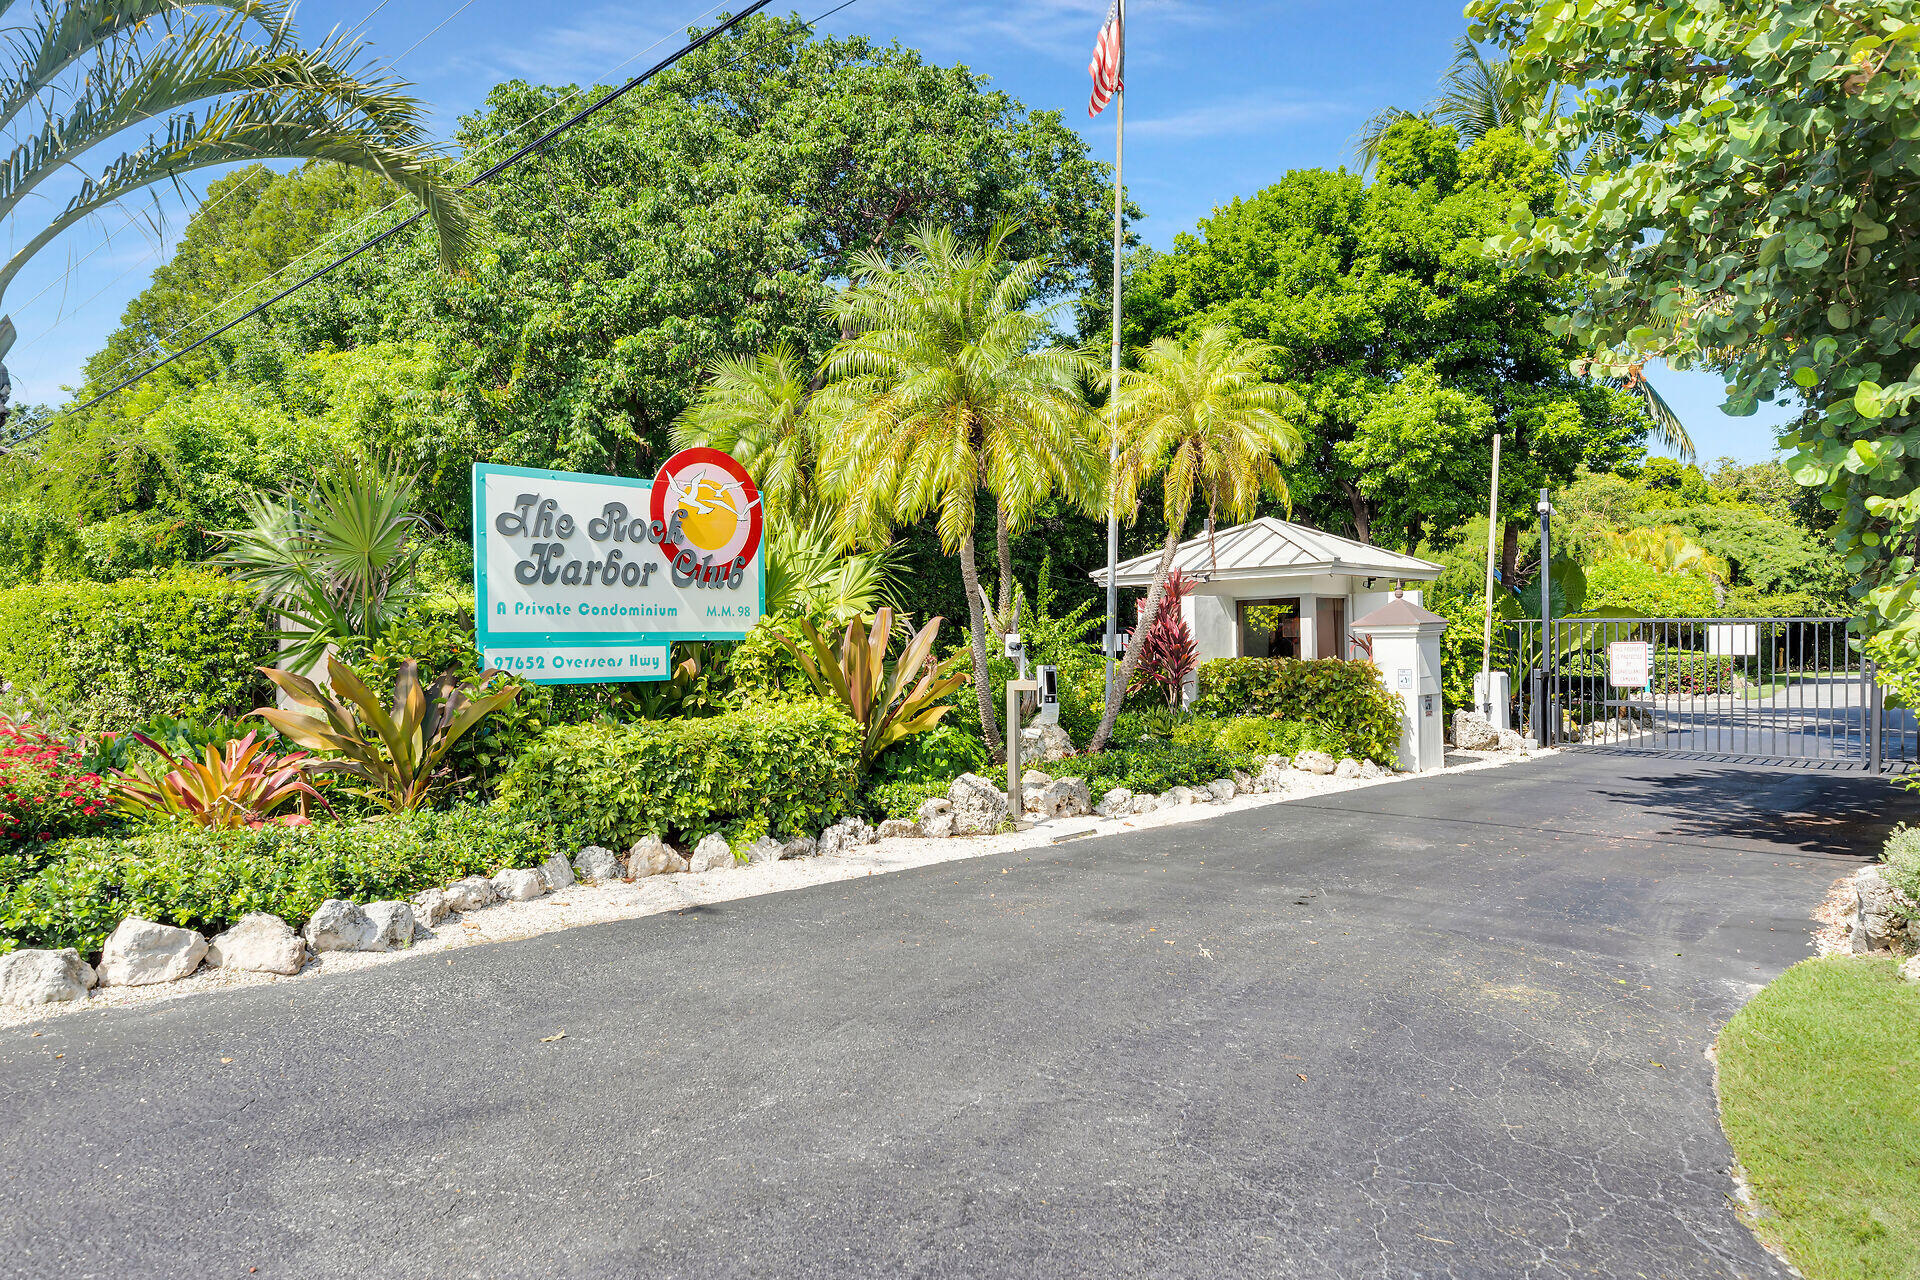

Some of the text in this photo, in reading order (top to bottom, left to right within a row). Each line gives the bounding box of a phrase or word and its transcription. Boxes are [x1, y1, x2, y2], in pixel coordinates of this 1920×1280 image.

[496, 493, 688, 545] The Rock
[514, 543, 746, 590] Harbor Club
[496, 602, 678, 617] A Private Condominium
[706, 606, 751, 617] M.M. 98
[494, 654, 660, 670] 97652 Overseas Hwy
